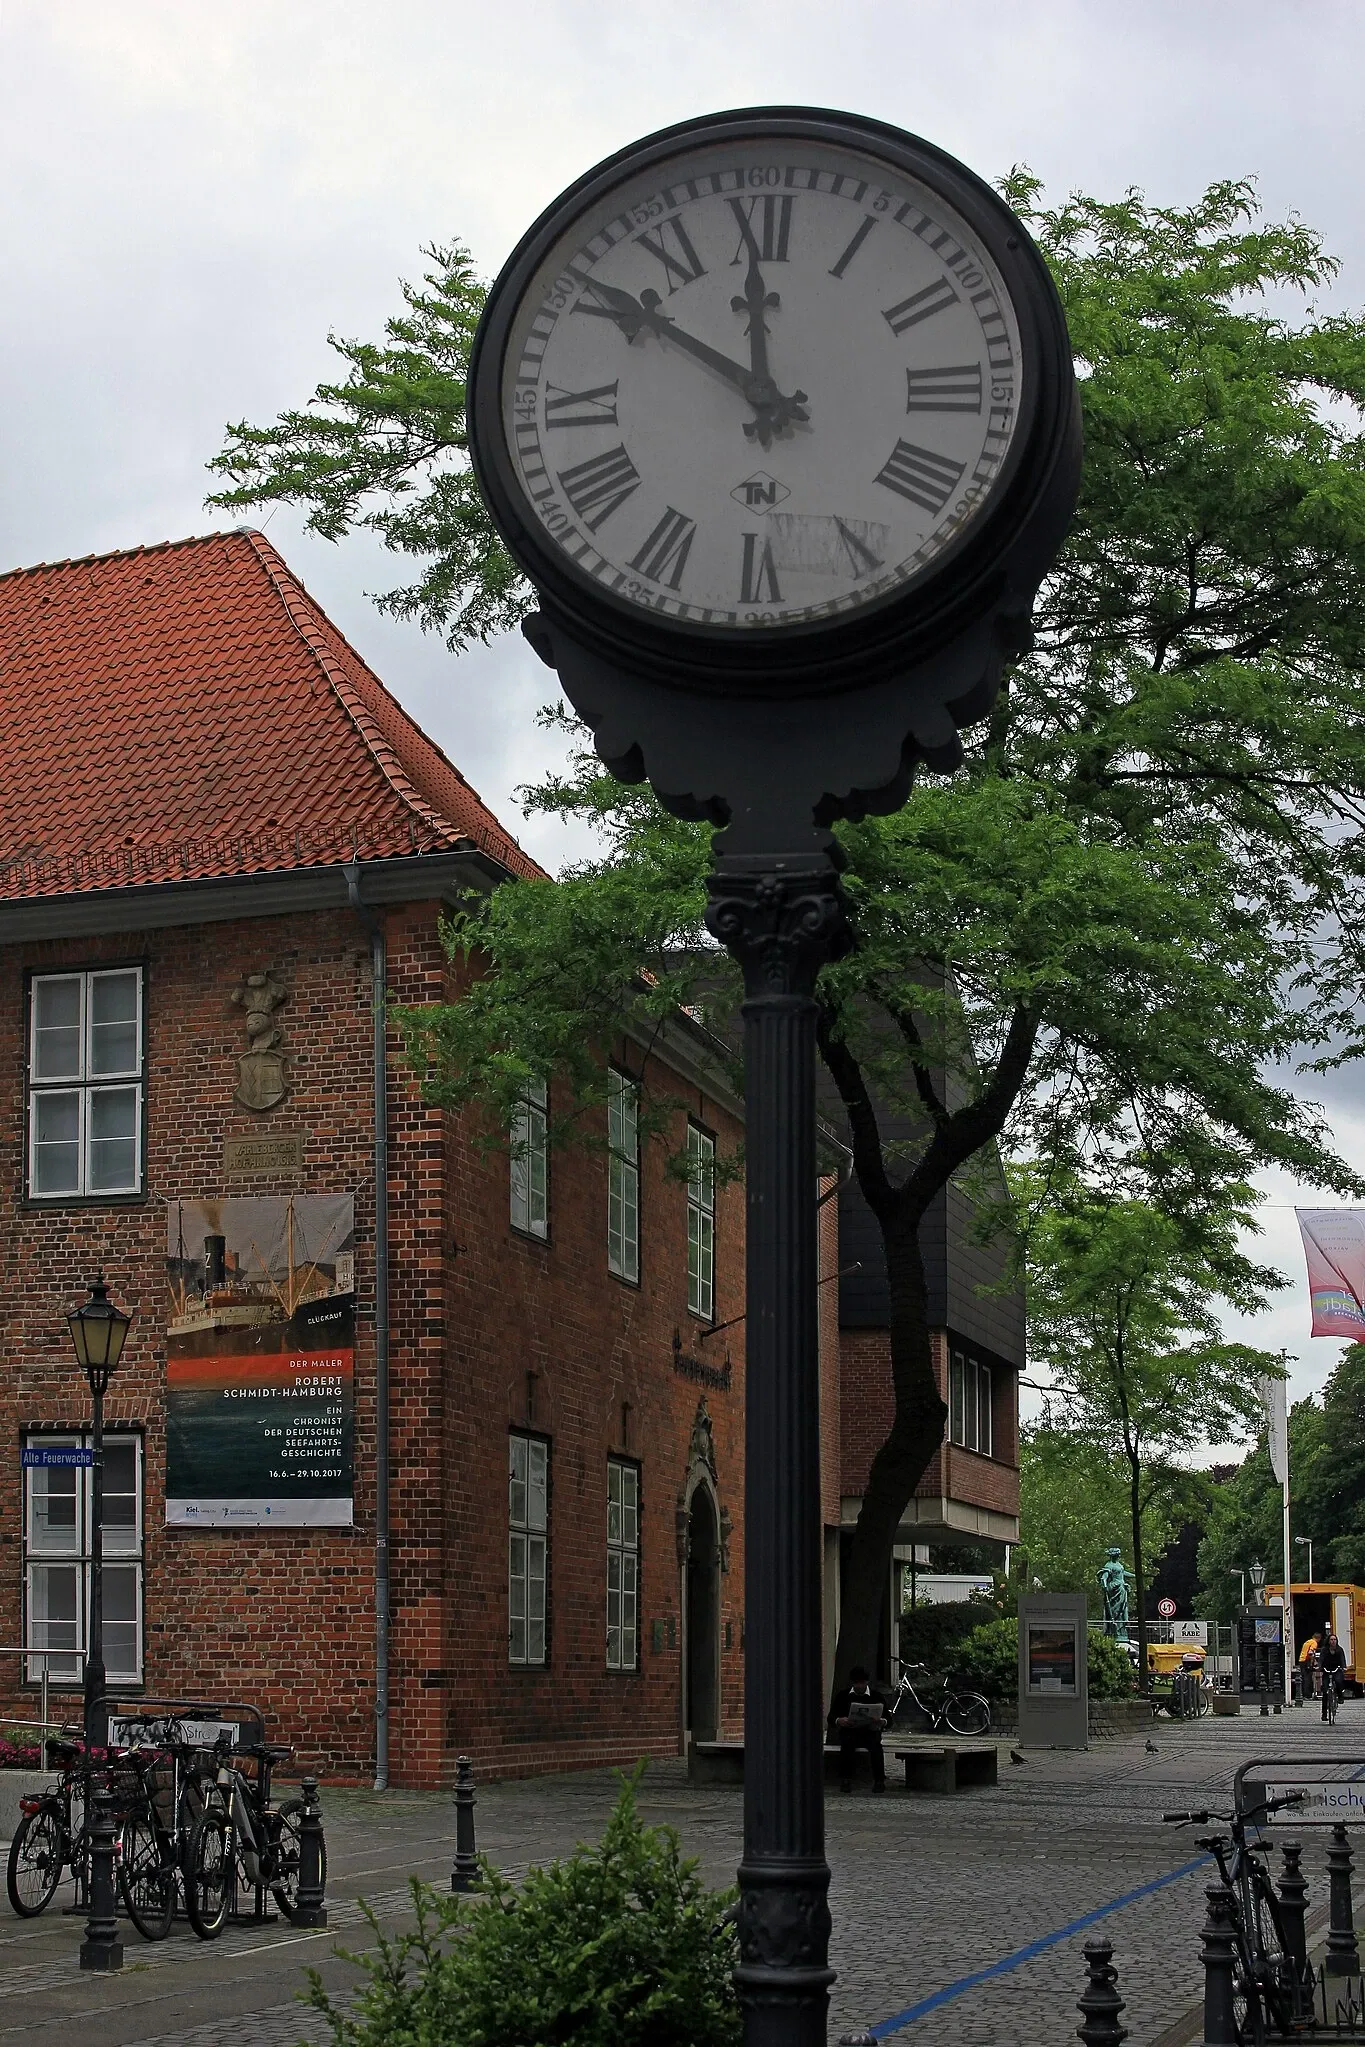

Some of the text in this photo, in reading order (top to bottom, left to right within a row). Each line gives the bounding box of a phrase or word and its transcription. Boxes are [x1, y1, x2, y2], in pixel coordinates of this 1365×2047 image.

[748, 166, 781, 188] 60
[631, 196, 665, 225] 55
[872, 188, 893, 213] 5
[723, 193, 798, 266] XII
[631, 212, 709, 296] XI
[827, 213, 879, 281] I
[952, 260, 984, 290] 10
[548, 277, 575, 309] 50
[880, 273, 962, 338] II
[905, 361, 982, 416] III
[991, 375, 1014, 402] 15
[513, 388, 538, 421] 45
[544, 377, 620, 433] IX
[555, 441, 644, 536] VIII
[871, 436, 968, 520] IIII
[538, 500, 569, 532] 40
[624, 504, 698, 592] VII
[832, 513, 887, 581] V
[737, 532, 786, 604] VI
[289, 1359, 343, 1368] DER MALER
[223, 1387, 343, 1398] SCHMIDT-HAMBURG
[295, 1376, 343, 1386] ROBERT
[293, 1417, 343, 1426] CHRONIST
[326, 1406, 343, 1415] EIN
[264, 1427, 343, 1437] DER DEUTSCHEN
[285, 1438, 342, 1447] SEEFAHRTS-
[23, 1451, 91, 1464] Alte Feuerwache
[281, 1448, 342, 1458] GESCHICHTE
